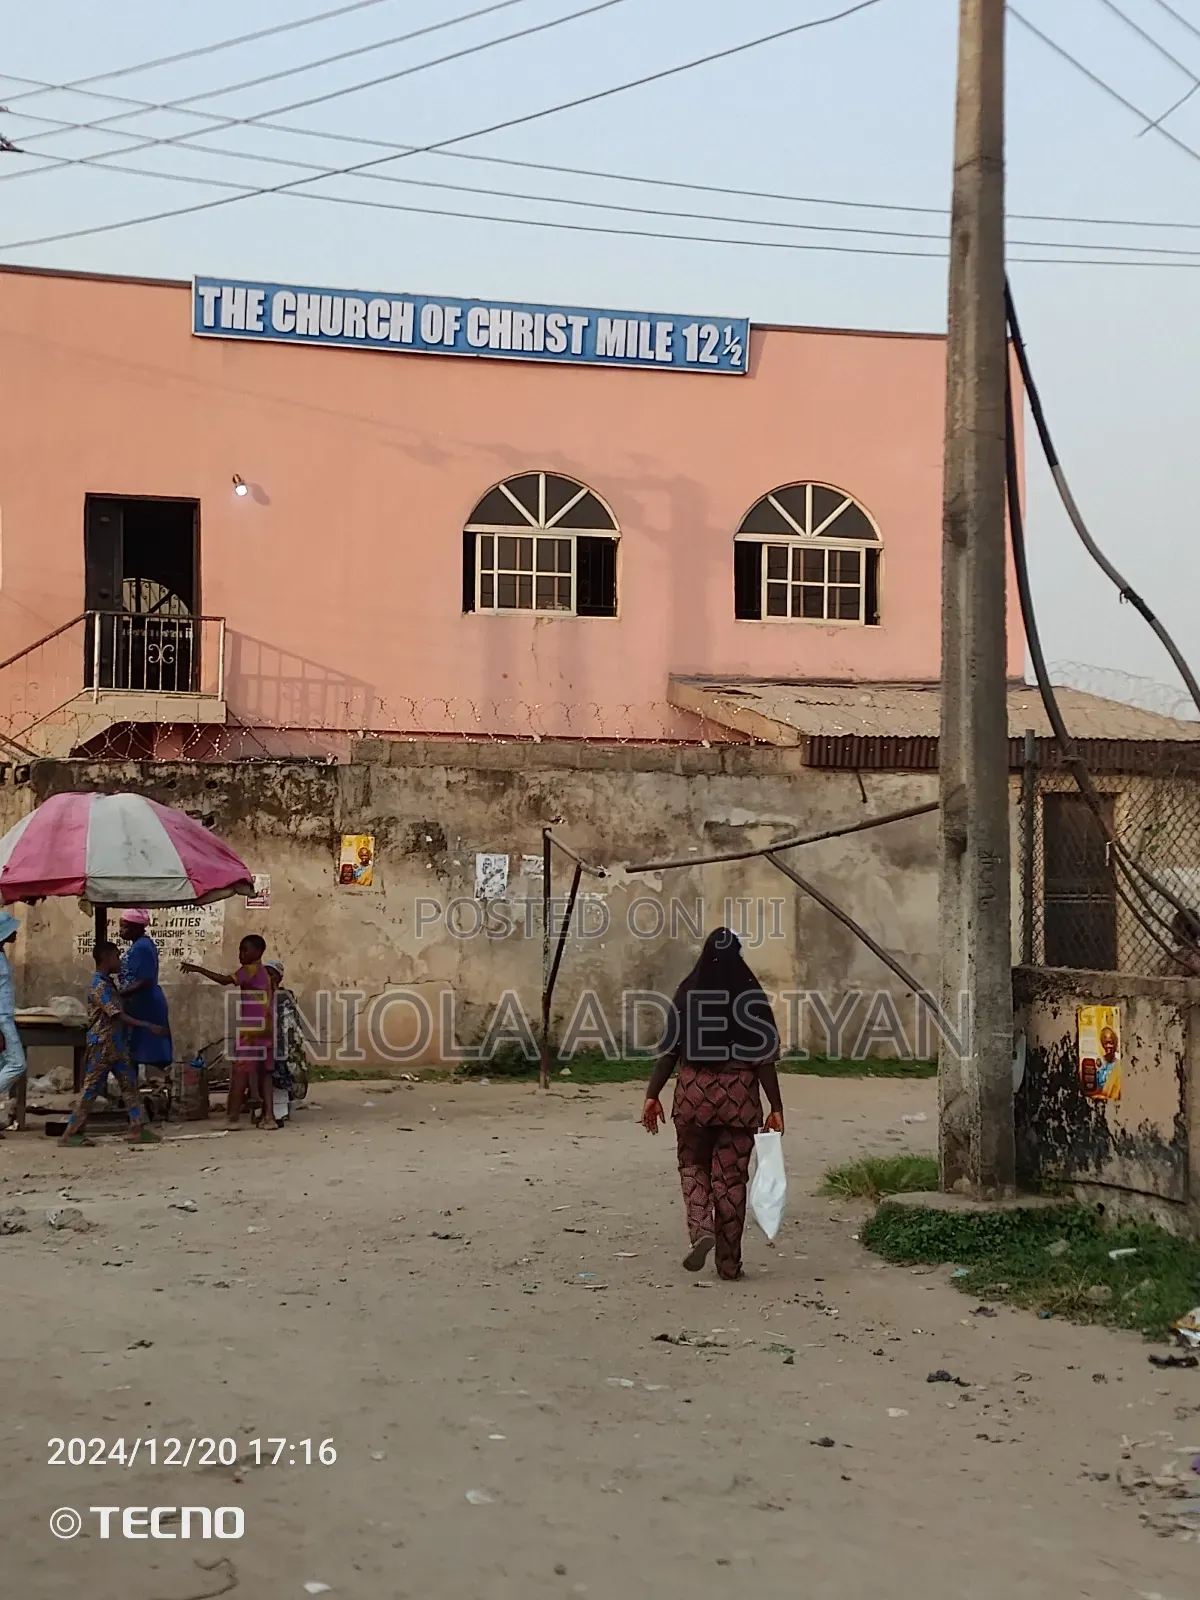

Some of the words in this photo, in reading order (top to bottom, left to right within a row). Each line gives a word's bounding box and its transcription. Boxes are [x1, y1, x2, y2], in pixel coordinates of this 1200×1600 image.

[198, 286, 266, 333] THE
[271, 290, 416, 345] CHURCH
[420, 303, 463, 347] OF
[466, 307, 589, 355] CHRIST
[596, 319, 674, 363] MILE
